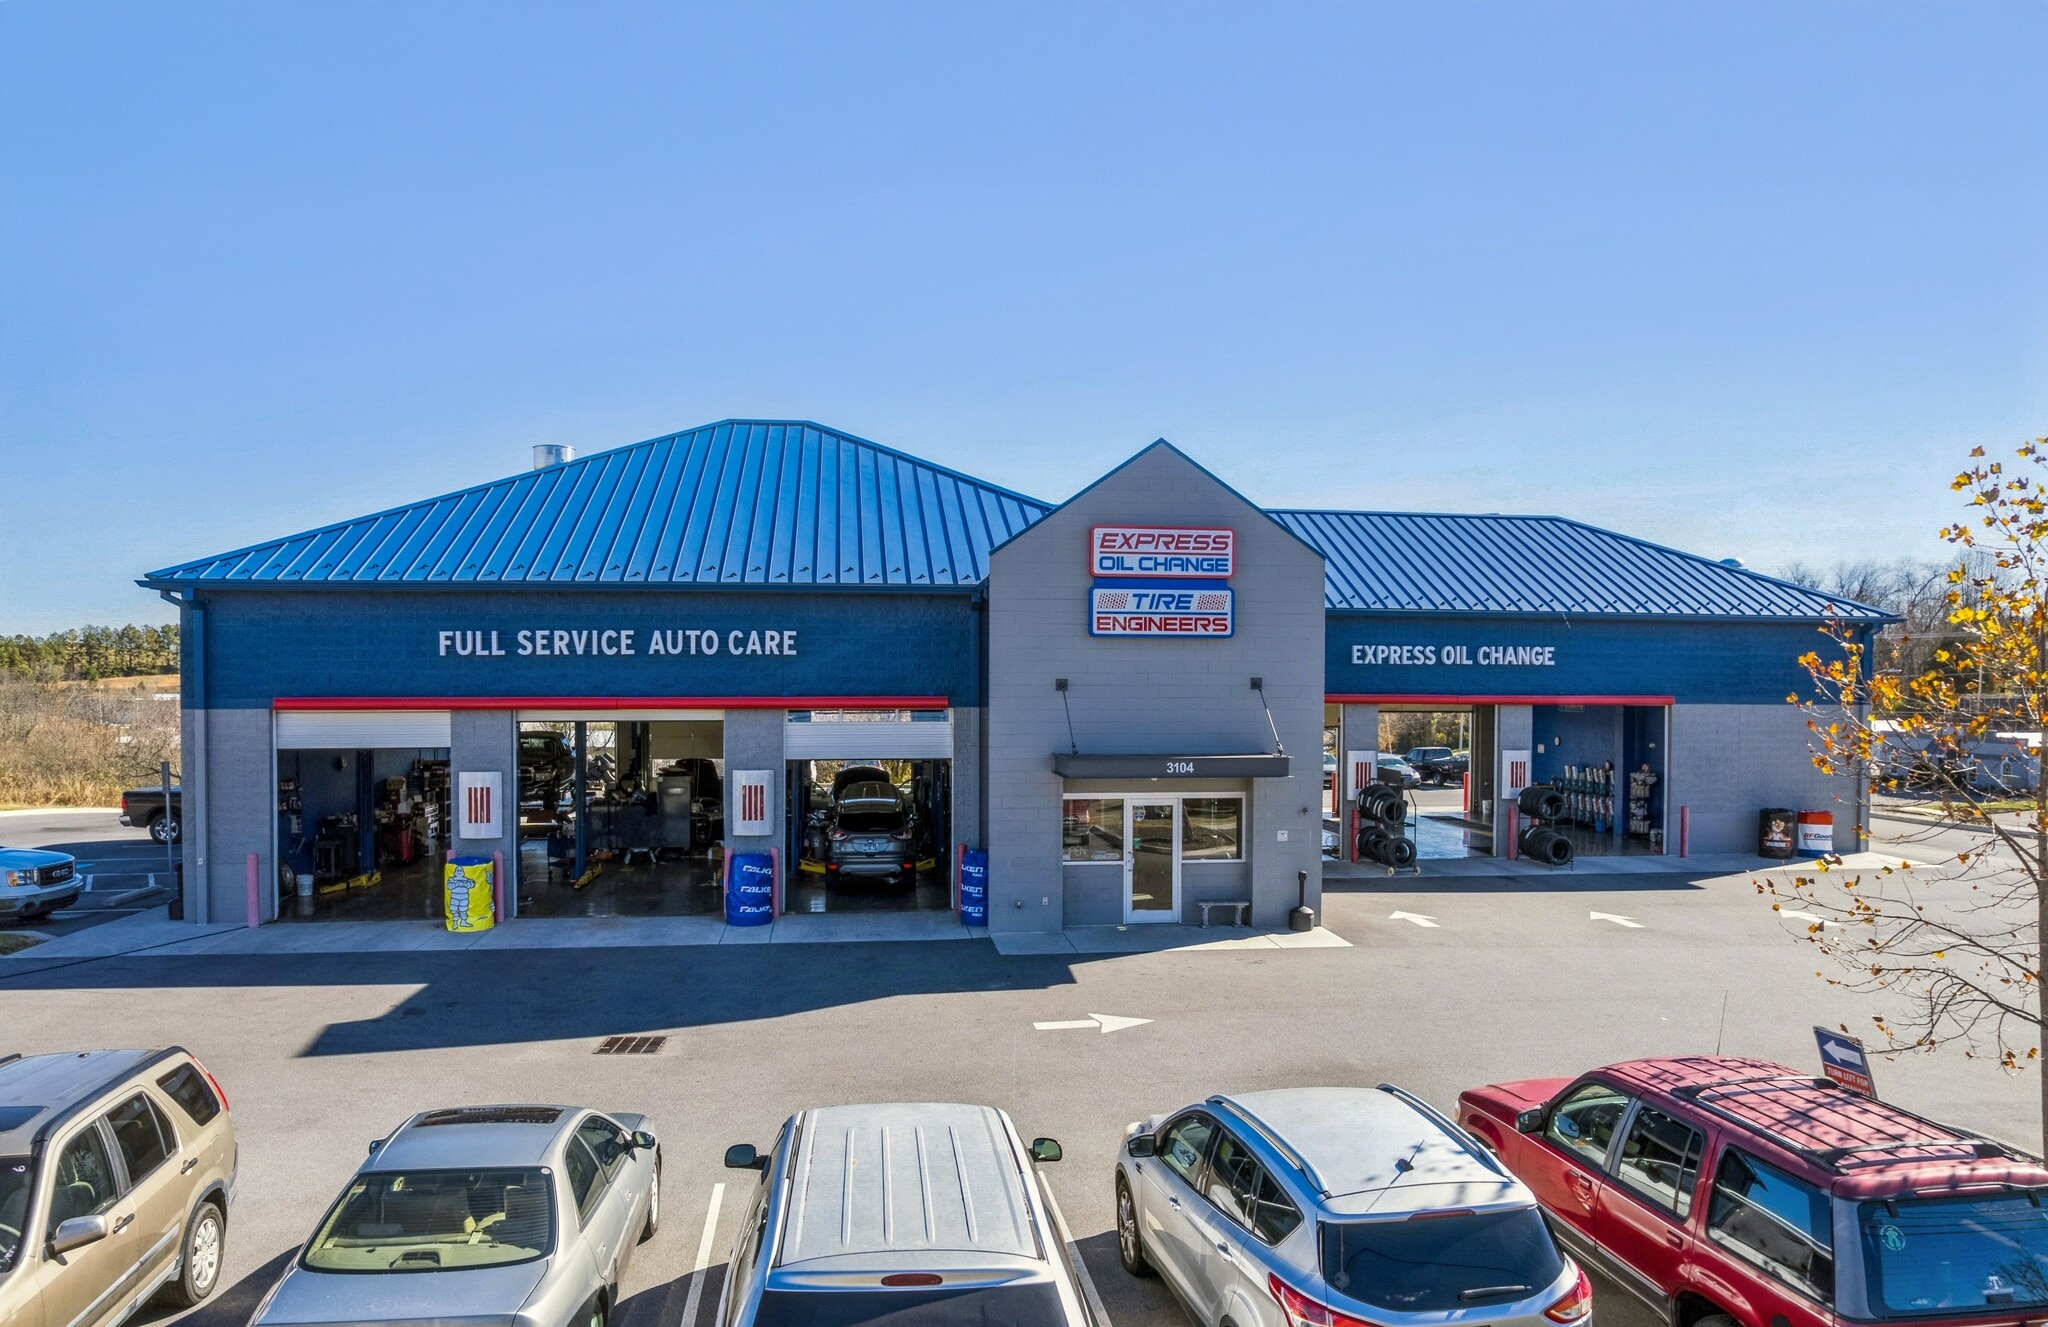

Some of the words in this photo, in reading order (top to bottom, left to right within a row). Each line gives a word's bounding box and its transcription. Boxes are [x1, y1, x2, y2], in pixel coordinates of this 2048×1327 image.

[1099, 532, 1230, 550] EXPRESS
[1099, 556, 1134, 571] OIL
[1138, 556, 1229, 572] CHANGE
[1132, 593, 1194, 610] TIRE
[1096, 616, 1228, 632] ENGINEERS
[439, 631, 505, 656] FULL
[517, 630, 635, 656] SERVICE
[648, 630, 719, 655] AUTO
[728, 630, 797, 655] CARE
[1351, 645, 1436, 665] EXPRESS
[1440, 645, 1473, 665] OIL
[1477, 646, 1555, 665] CHANGE
[1166, 762, 1194, 773] 3104
[1826, 1066, 1843, 1078] TURN
[1843, 1072, 1856, 1083] LEFT
[1857, 1077, 1869, 1088] FOR
